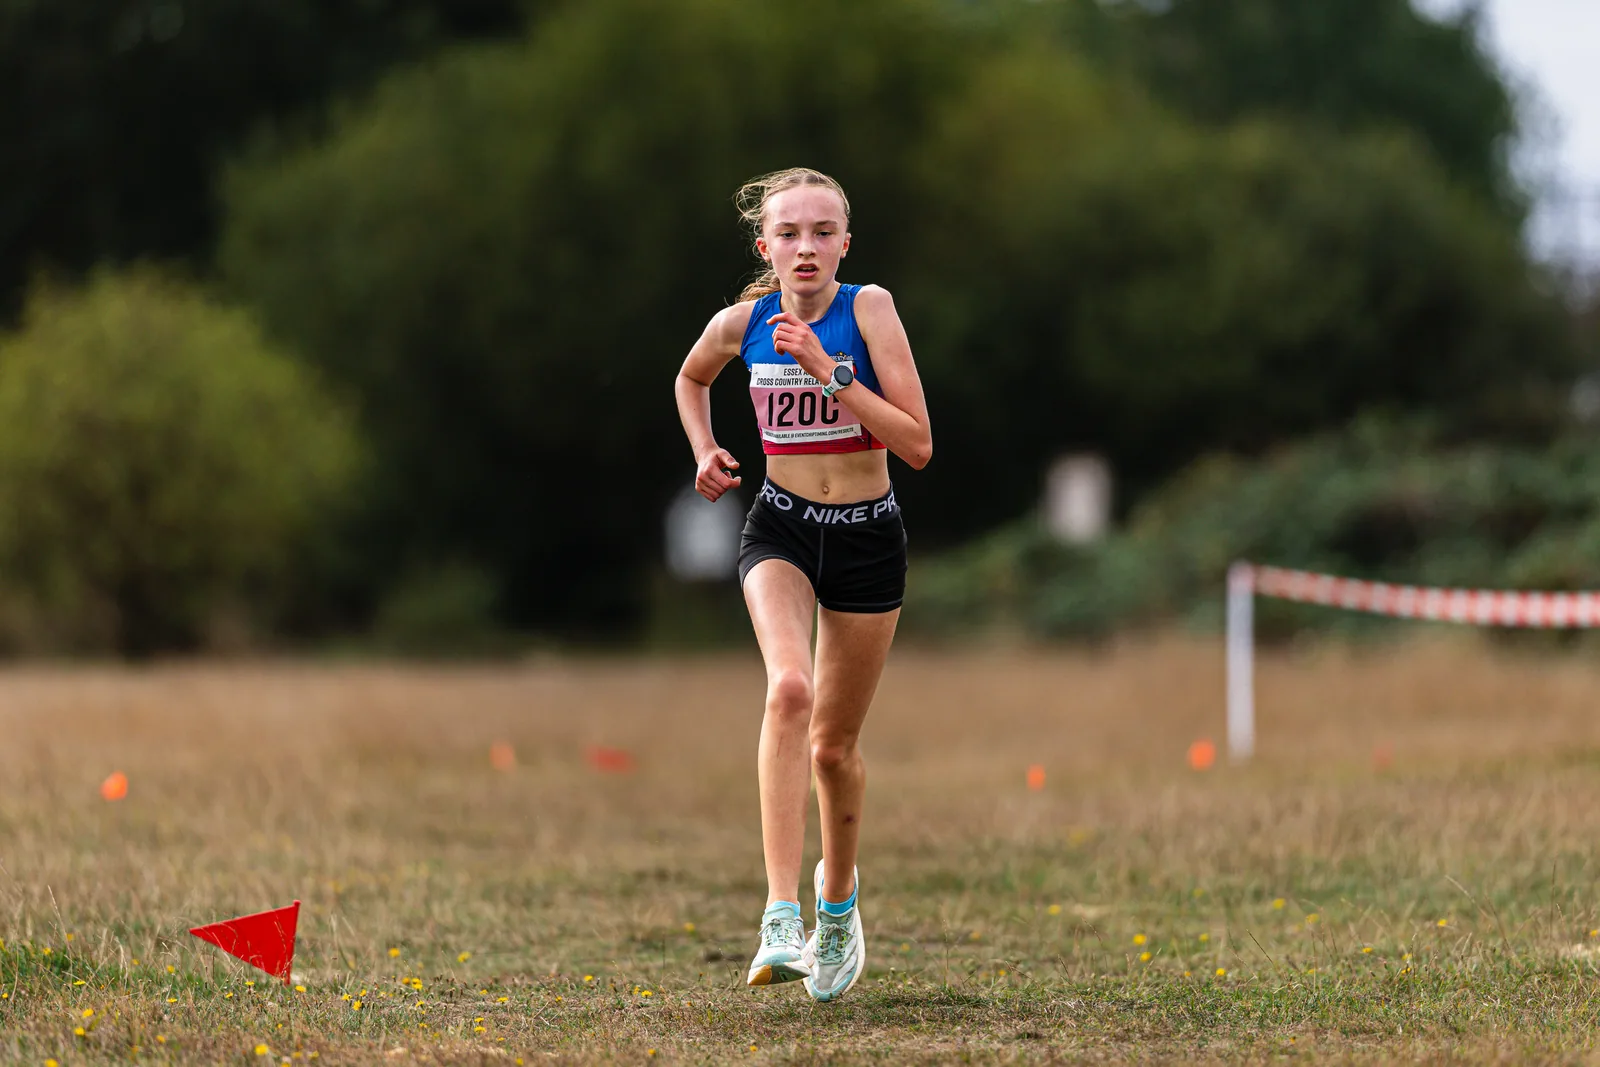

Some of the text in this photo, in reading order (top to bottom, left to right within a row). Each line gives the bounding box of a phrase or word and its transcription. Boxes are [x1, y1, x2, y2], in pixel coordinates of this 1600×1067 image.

[783, 368, 802, 376] ESSEX
[756, 377, 823, 386] CROSS COUNTRY RELA
[803, 506, 868, 524] NIKE
